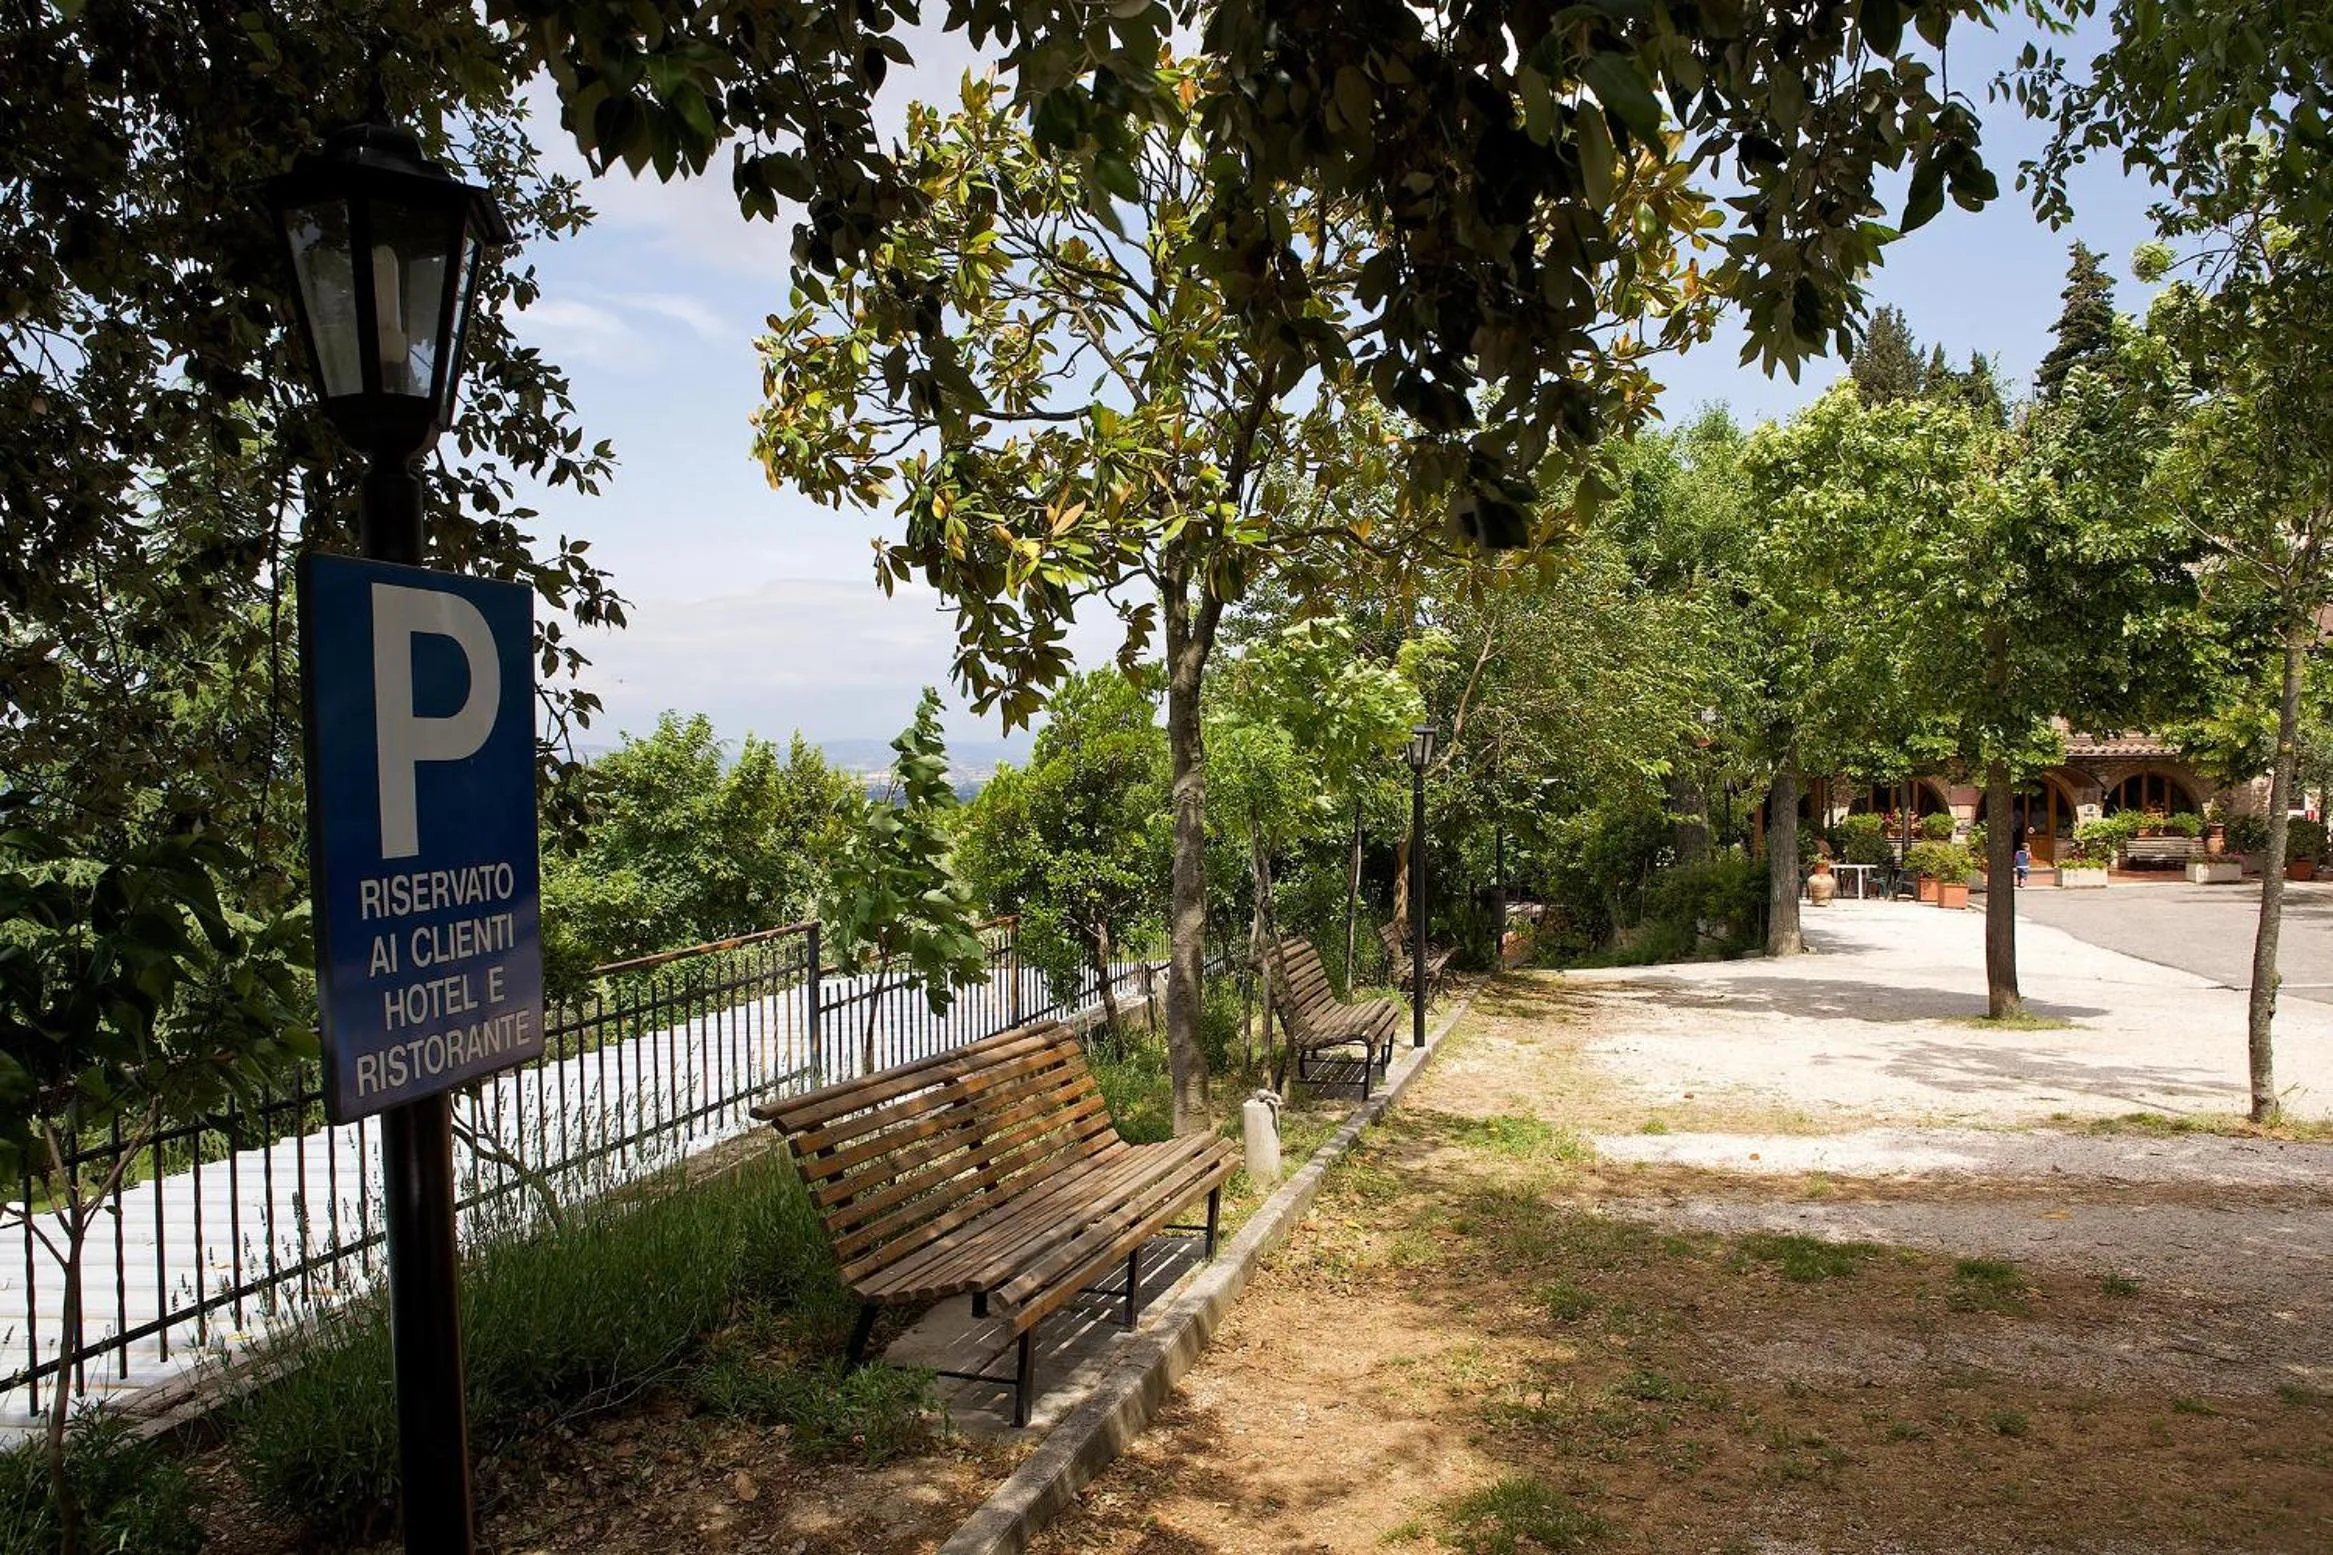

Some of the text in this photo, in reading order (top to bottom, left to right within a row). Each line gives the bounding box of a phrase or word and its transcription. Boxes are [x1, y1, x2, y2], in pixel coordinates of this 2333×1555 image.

[371, 582, 501, 860] P
[361, 862, 514, 920] RISERVATO
[370, 912, 514, 978] AI CLIENTI
[385, 966, 505, 1030] HOTEL E
[357, 1009, 531, 1097] RISTORANTE
